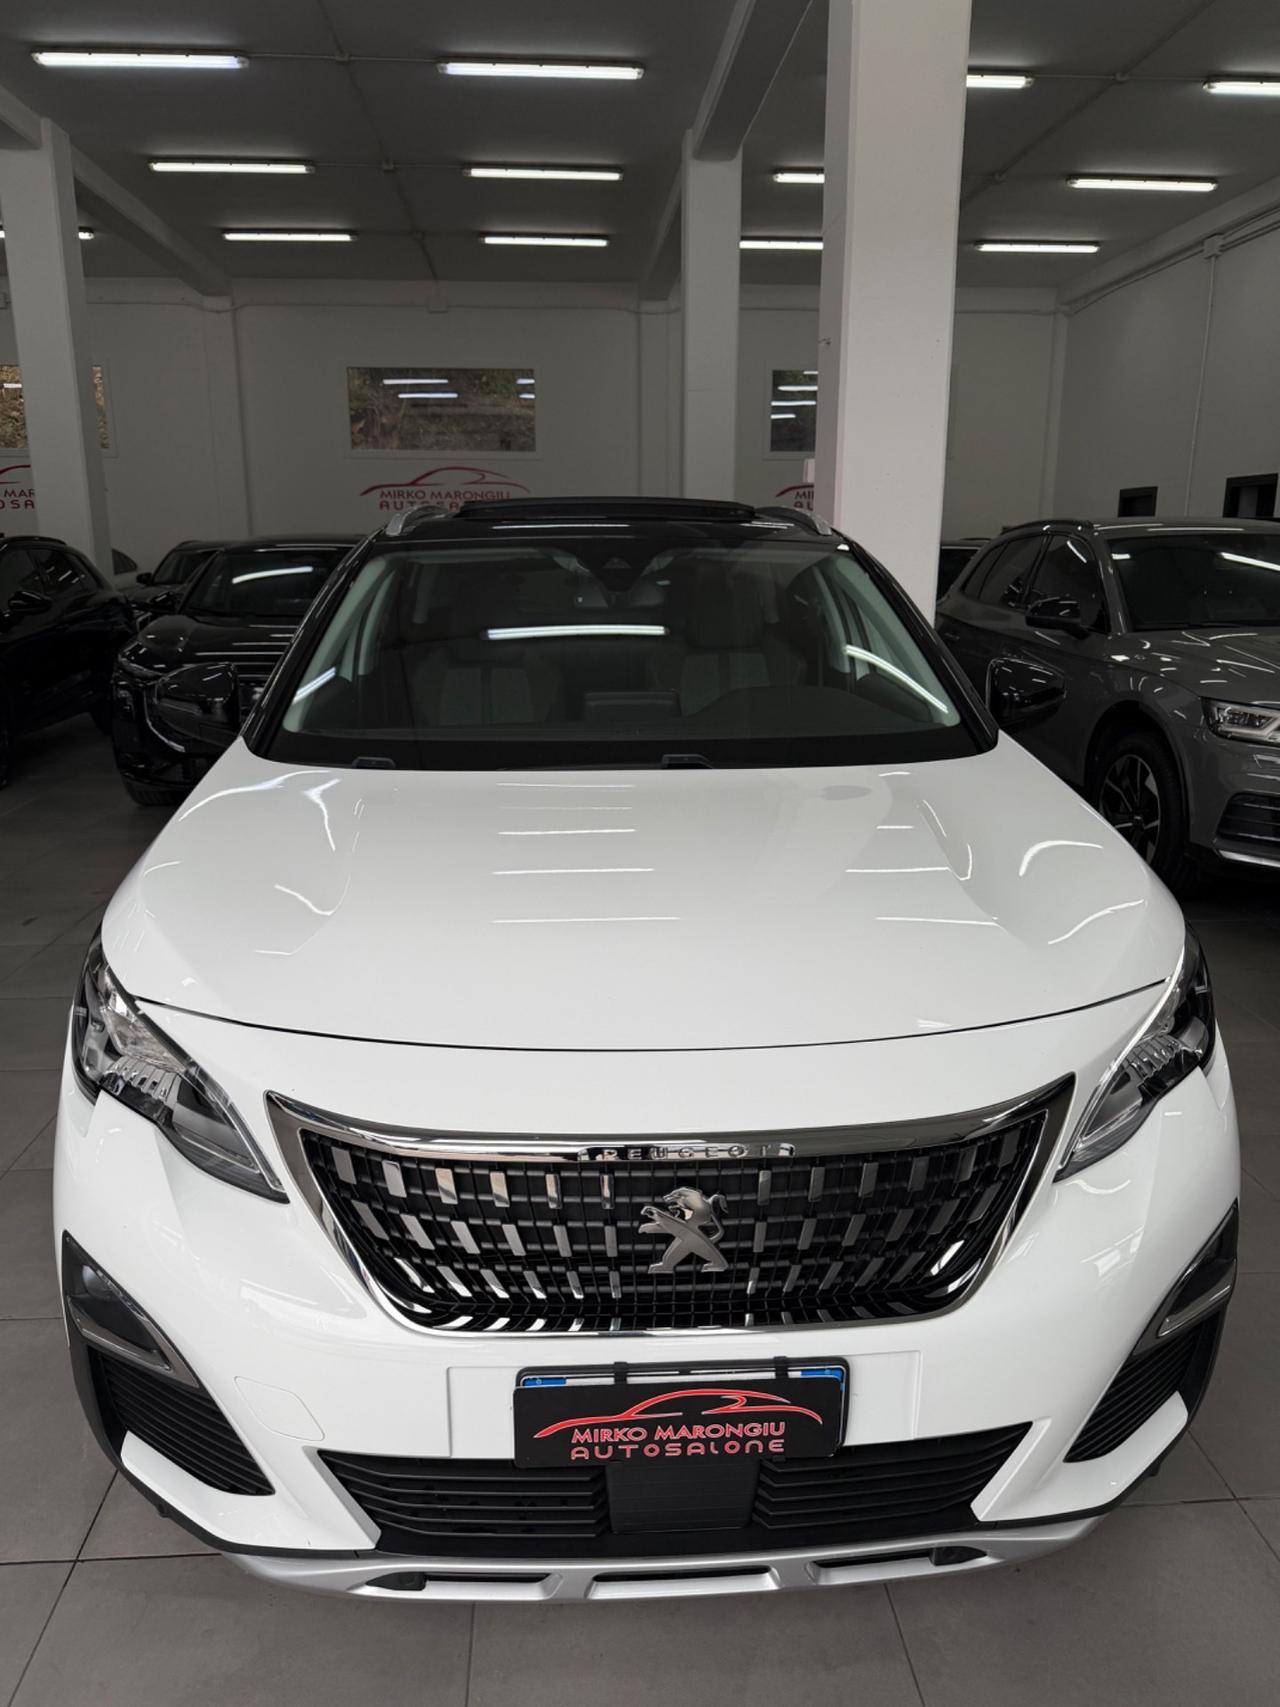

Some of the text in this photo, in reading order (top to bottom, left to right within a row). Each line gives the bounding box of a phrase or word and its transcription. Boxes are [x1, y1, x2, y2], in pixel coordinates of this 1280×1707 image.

[379, 490, 511, 500] MIRKO MARONGIU
[602, 1143, 772, 1160] PEUGEOT
[571, 1421, 786, 1444] MIRKO MARONGIU
[570, 1438, 785, 1461] AUTOSALONE
